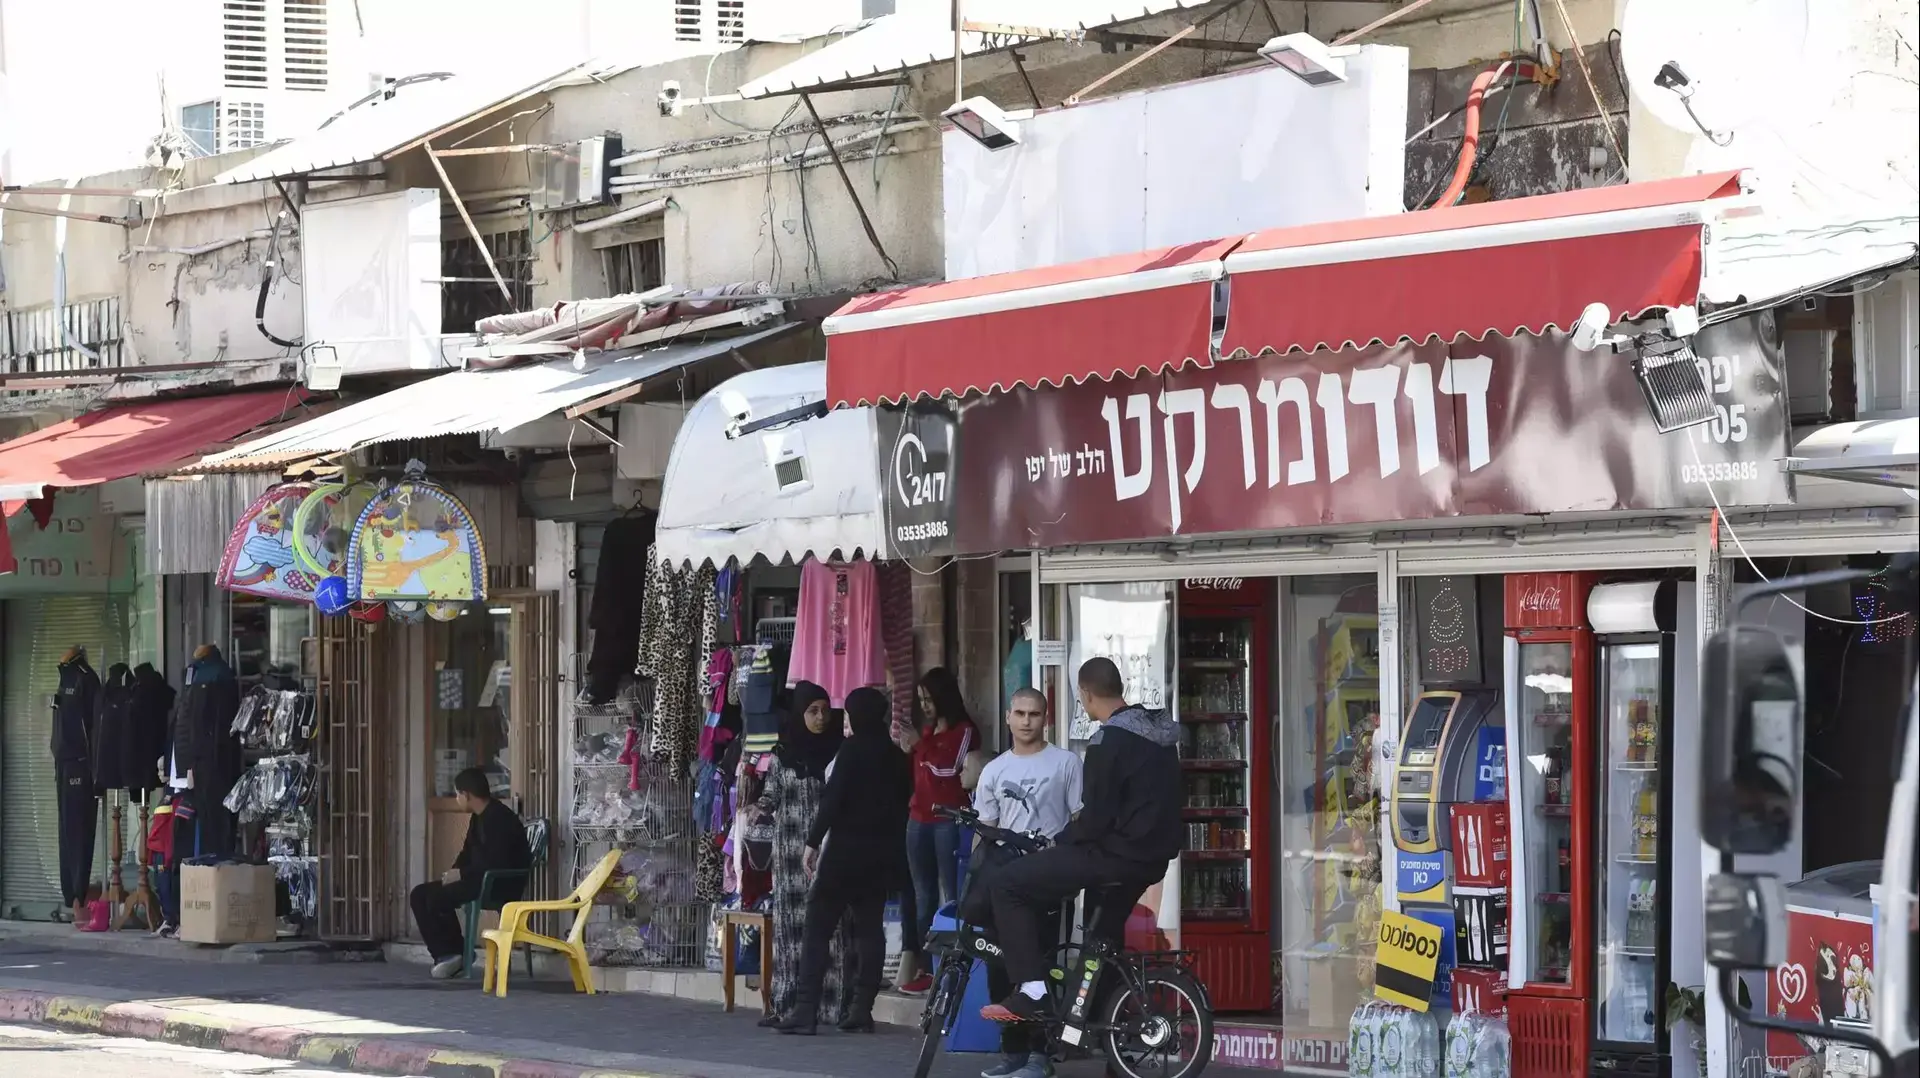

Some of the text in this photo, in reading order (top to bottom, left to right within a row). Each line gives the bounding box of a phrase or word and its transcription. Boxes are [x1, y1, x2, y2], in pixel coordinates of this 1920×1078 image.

[1101, 354, 1493, 535] דודומרקט
[1025, 442, 1106, 483] הלב של יפו
[1681, 462, 1758, 484] 035353886
[911, 471, 946, 506] 24/7
[897, 521, 949, 542] 035353886
[1449, 806, 1455, 817] 6
[1400, 860, 1440, 871] משיכת מזומנים
[1413, 871, 1428, 886] כאן
[1454, 897, 1459, 909] 6
[1380, 922, 1438, 960] כספומט
[1211, 1031, 1277, 1062] לדודומרק
